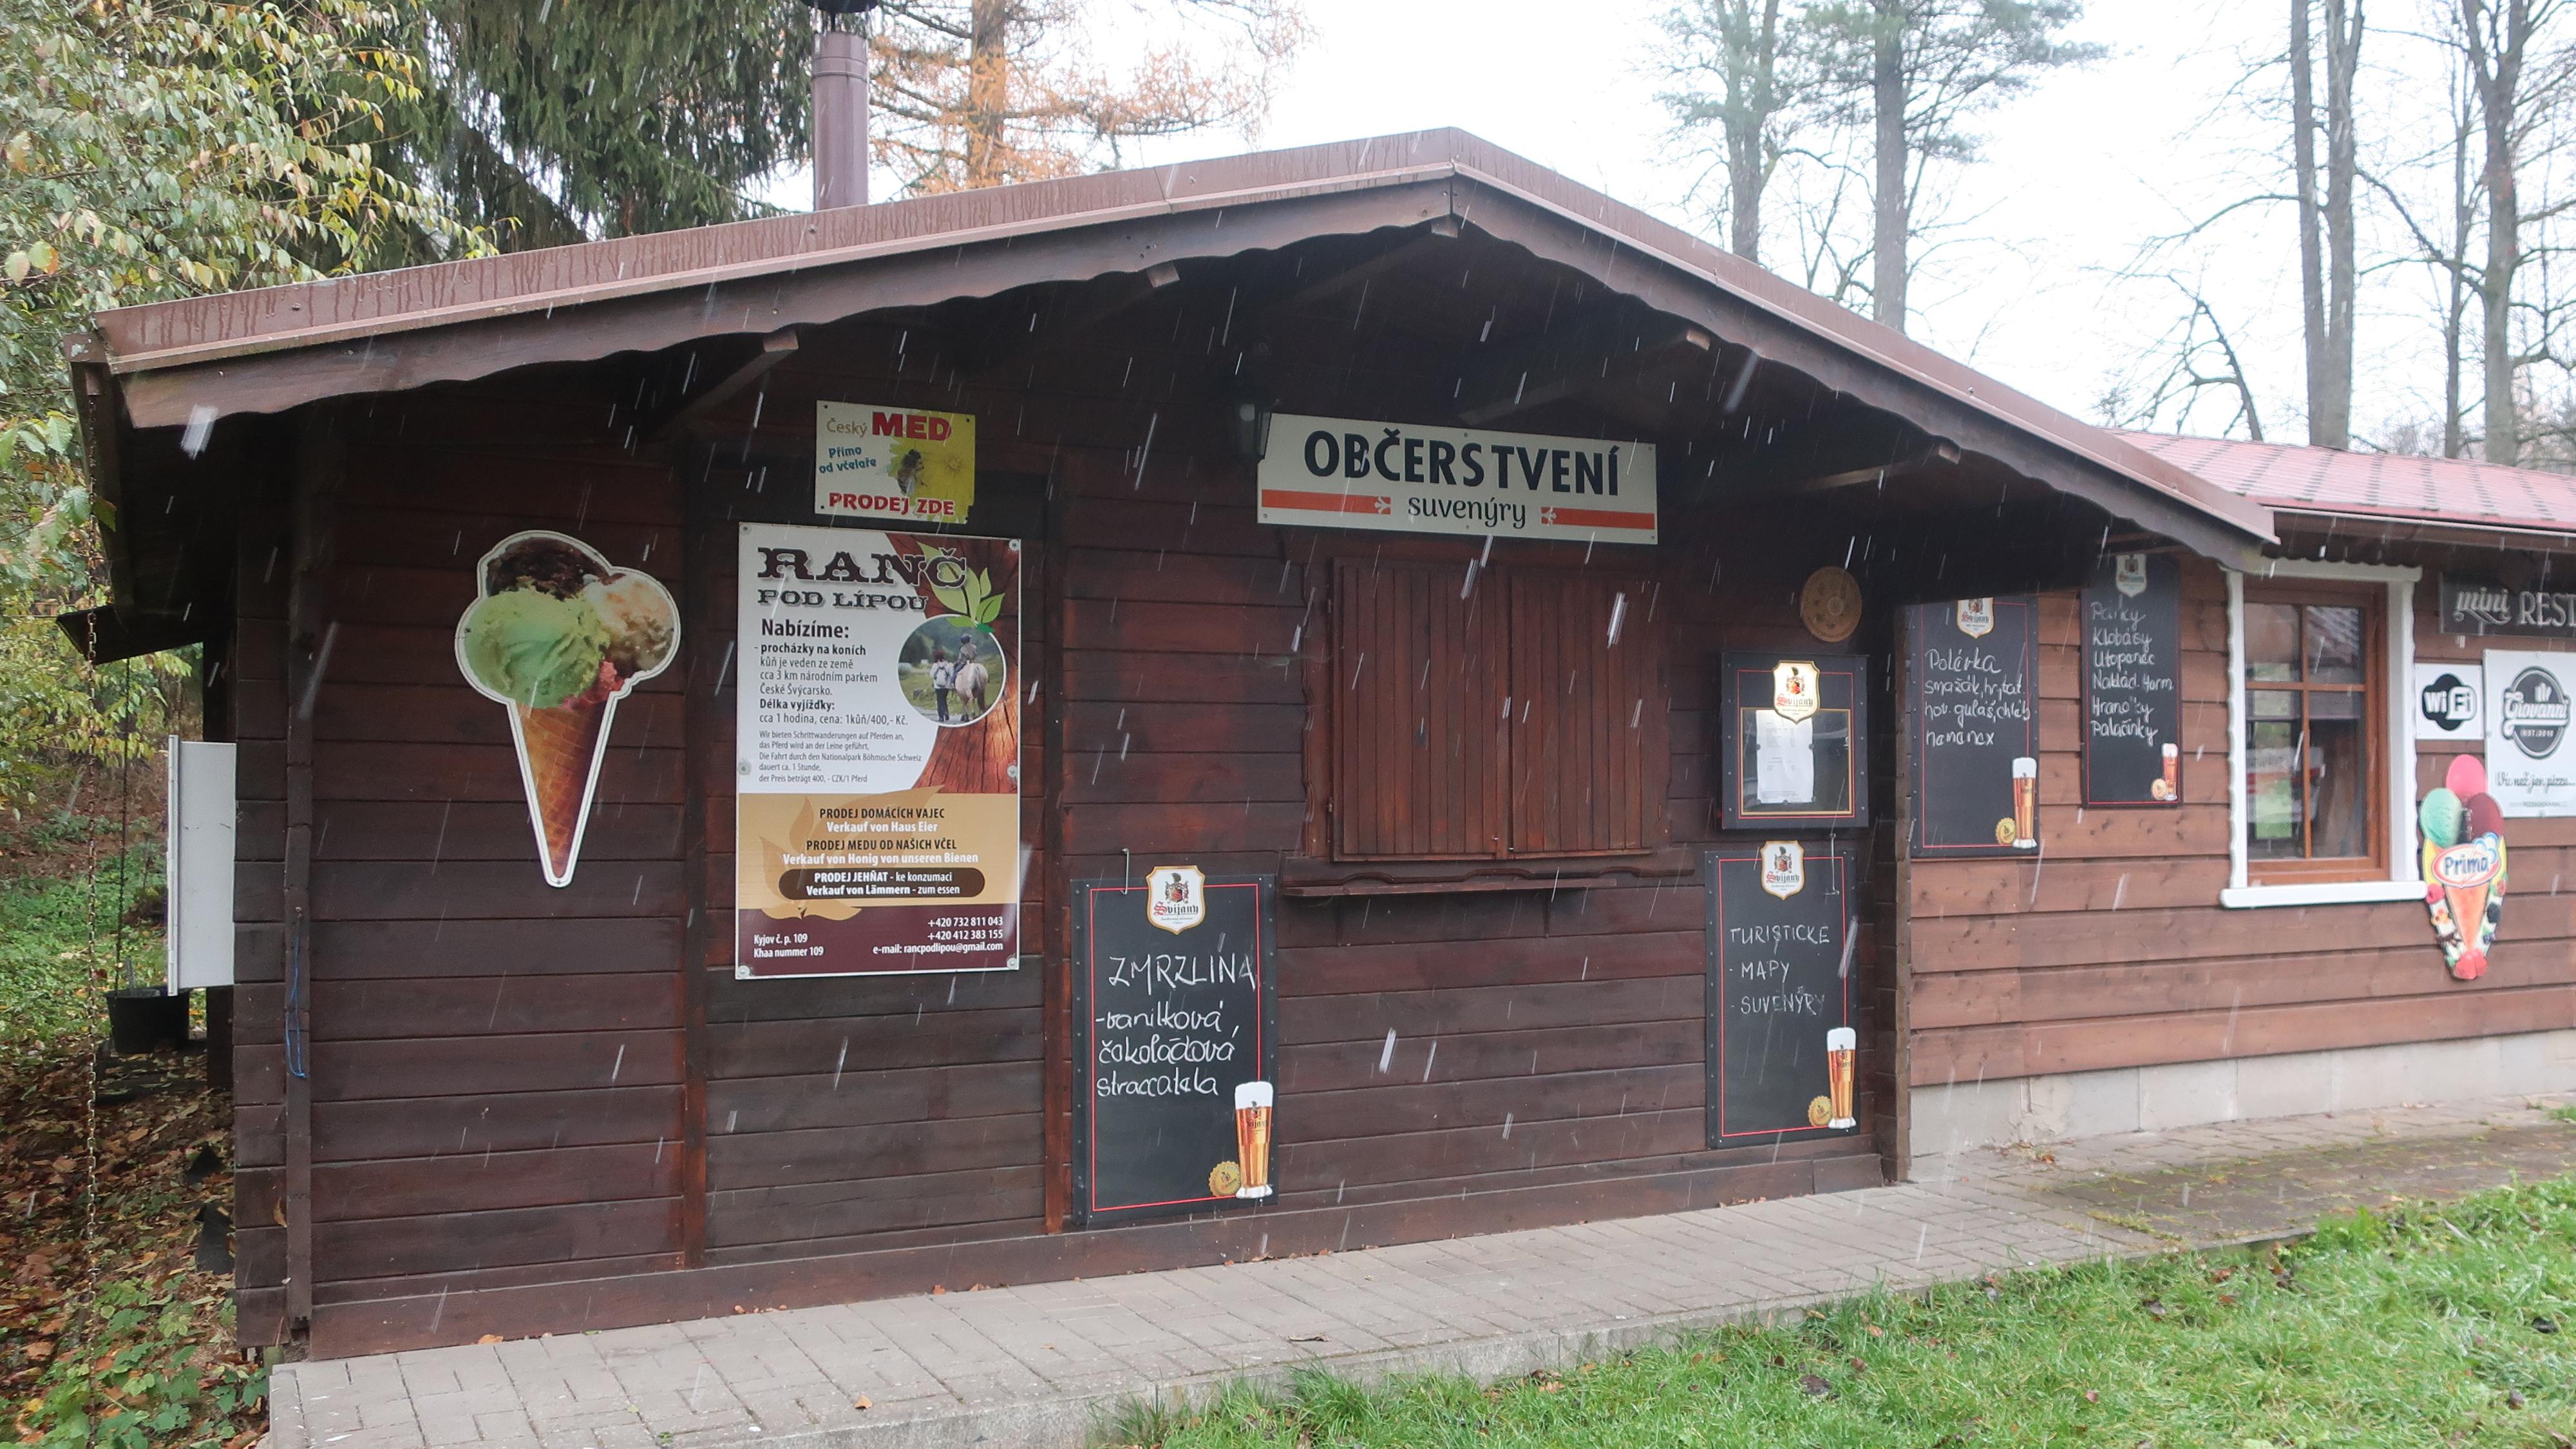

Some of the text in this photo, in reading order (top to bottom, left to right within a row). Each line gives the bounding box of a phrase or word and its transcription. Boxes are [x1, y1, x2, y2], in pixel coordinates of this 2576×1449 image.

[826, 412, 951, 441] Český MED
[828, 446, 862, 458] Přímo
[819, 458, 876, 474] od včelaře
[1303, 427, 1620, 497] OBČERSTVENÍ
[829, 493, 955, 515] PRODEJ ZDE
[1407, 497, 1526, 529] suvenýry
[758, 547, 967, 587] RANČ
[758, 590, 928, 610] POD LÍPOU
[2453, 587, 2512, 621] mini
[762, 618, 849, 638] Nabízíme:
[761, 643, 814, 656] procházky
[832, 644, 866, 655] koních
[760, 657, 777, 667] kůň
[779, 659, 787, 668] je
[790, 659, 816, 668] veden
[830, 659, 853, 668] země
[784, 672, 797, 680] km
[800, 672, 843, 681] národním
[846, 672, 877, 683] parkem
[760, 684, 832, 696] České Švýcarsko.
[760, 699, 835, 711] Délka vyjížďky:
[1777, 694, 1813, 706] Svijany
[776, 714, 781, 723] 1
[783, 714, 817, 724] hodina,
[896, 715, 908, 725] Kč.
[793, 732, 857, 741] Schrittwanderungen
[822, 753, 860, 762] Nationalpark
[798, 764, 822, 772] Stunde,
[787, 775, 811, 784] beträgt
[820, 806, 944, 819] PRODEJ DOMÁCÍCH VAJEC
[827, 822, 938, 833] Verkauf von Haus Eier
[806, 837, 957, 851] PRODEJ MEDU OD NAŠICH VČEL
[783, 853, 978, 867] Verkauf von Honig von unseren Bienen
[2445, 854, 2489, 876] Prima
[814, 872, 851, 883] PRODEJ
[896, 872, 905, 882] ke
[907, 872, 952, 882] konzumaci
[1766, 871, 1799, 883] Svijany
[806, 885, 844, 896] Verkauf
[846, 887, 864, 895] von
[866, 885, 910, 895] Lämmern
[918, 887, 934, 895] zum
[937, 887, 960, 895] essen
[1153, 901, 1198, 916] Svijany
[927, 916, 1003, 927] +420 732 811 043
[754, 933, 808, 946] Kyjov č. p. 109
[927, 929, 1003, 940] +420 412 383 155
[754, 947, 824, 958] Khaa nummer 109
[873, 942, 1003, 954] e-mail: rancpodlipou@gmail.com
[1108, 952, 1256, 995] ZMRZLINA
[1741, 960, 1789, 984] MAPY
